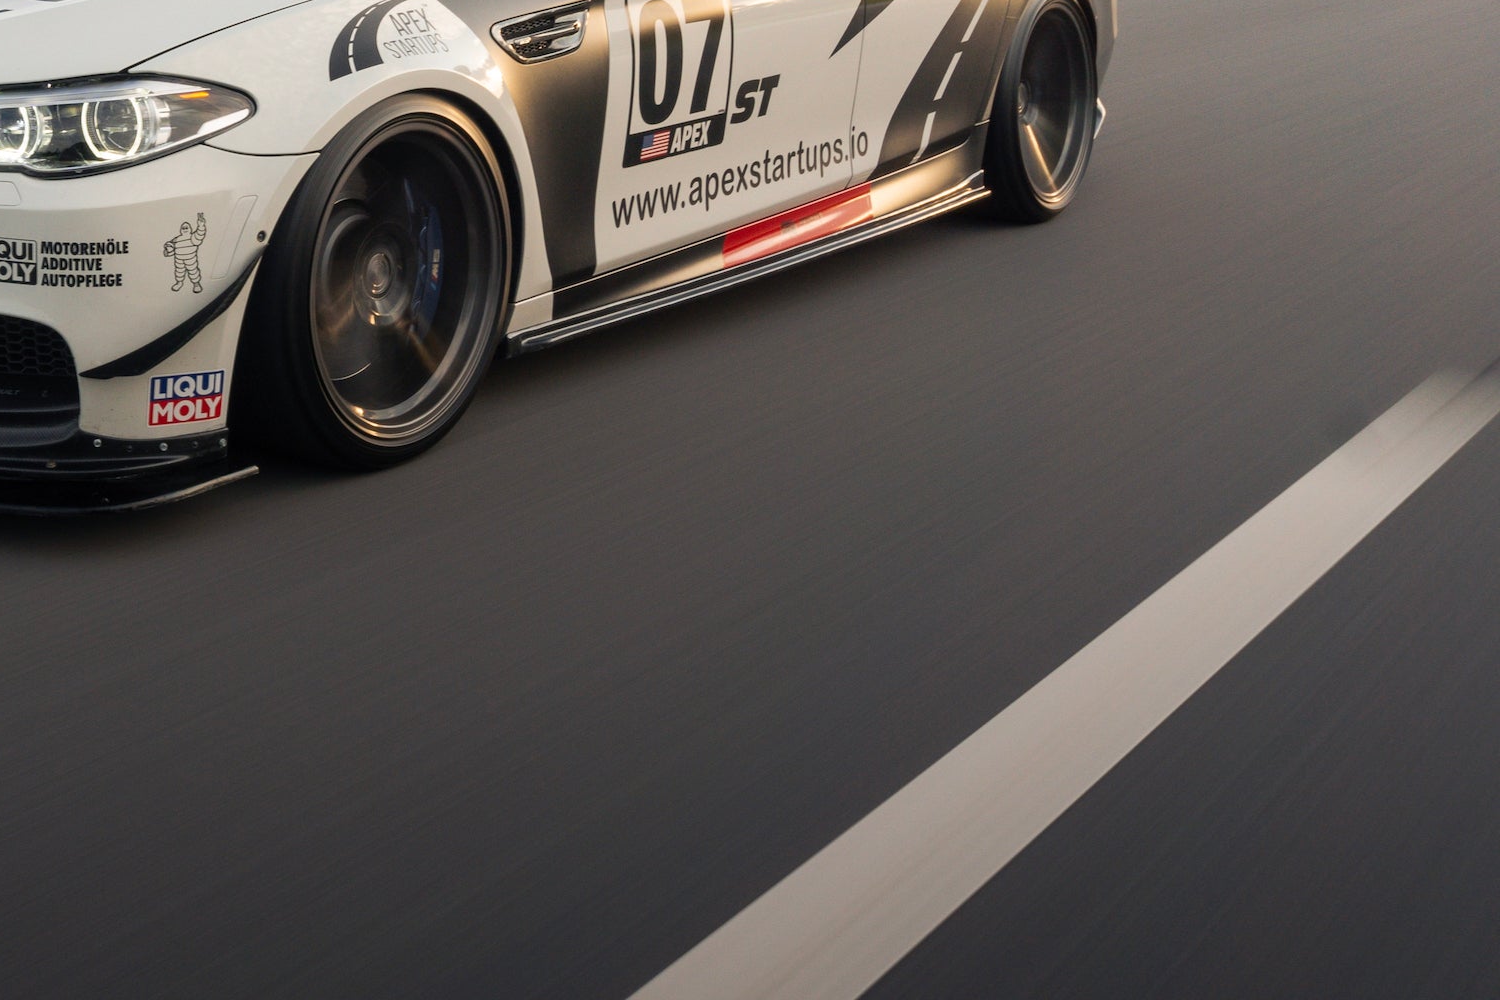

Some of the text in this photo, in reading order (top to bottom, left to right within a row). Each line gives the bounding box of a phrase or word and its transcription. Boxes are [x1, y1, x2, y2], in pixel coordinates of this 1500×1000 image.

[389, 8, 436, 37] APEX
[383, 32, 449, 58] STARTUPS
[729, 73, 781, 124] ST
[670, 119, 712, 154] APEX
[611, 125, 869, 229] www.apexstartups.io
[40, 238, 129, 255] MOTORENÖLE
[40, 257, 103, 271] ADDITIVE
[40, 273, 123, 288] AUTOPFLEGE
[153, 372, 222, 399] LIQUI
[151, 395, 222, 424] MOLY
